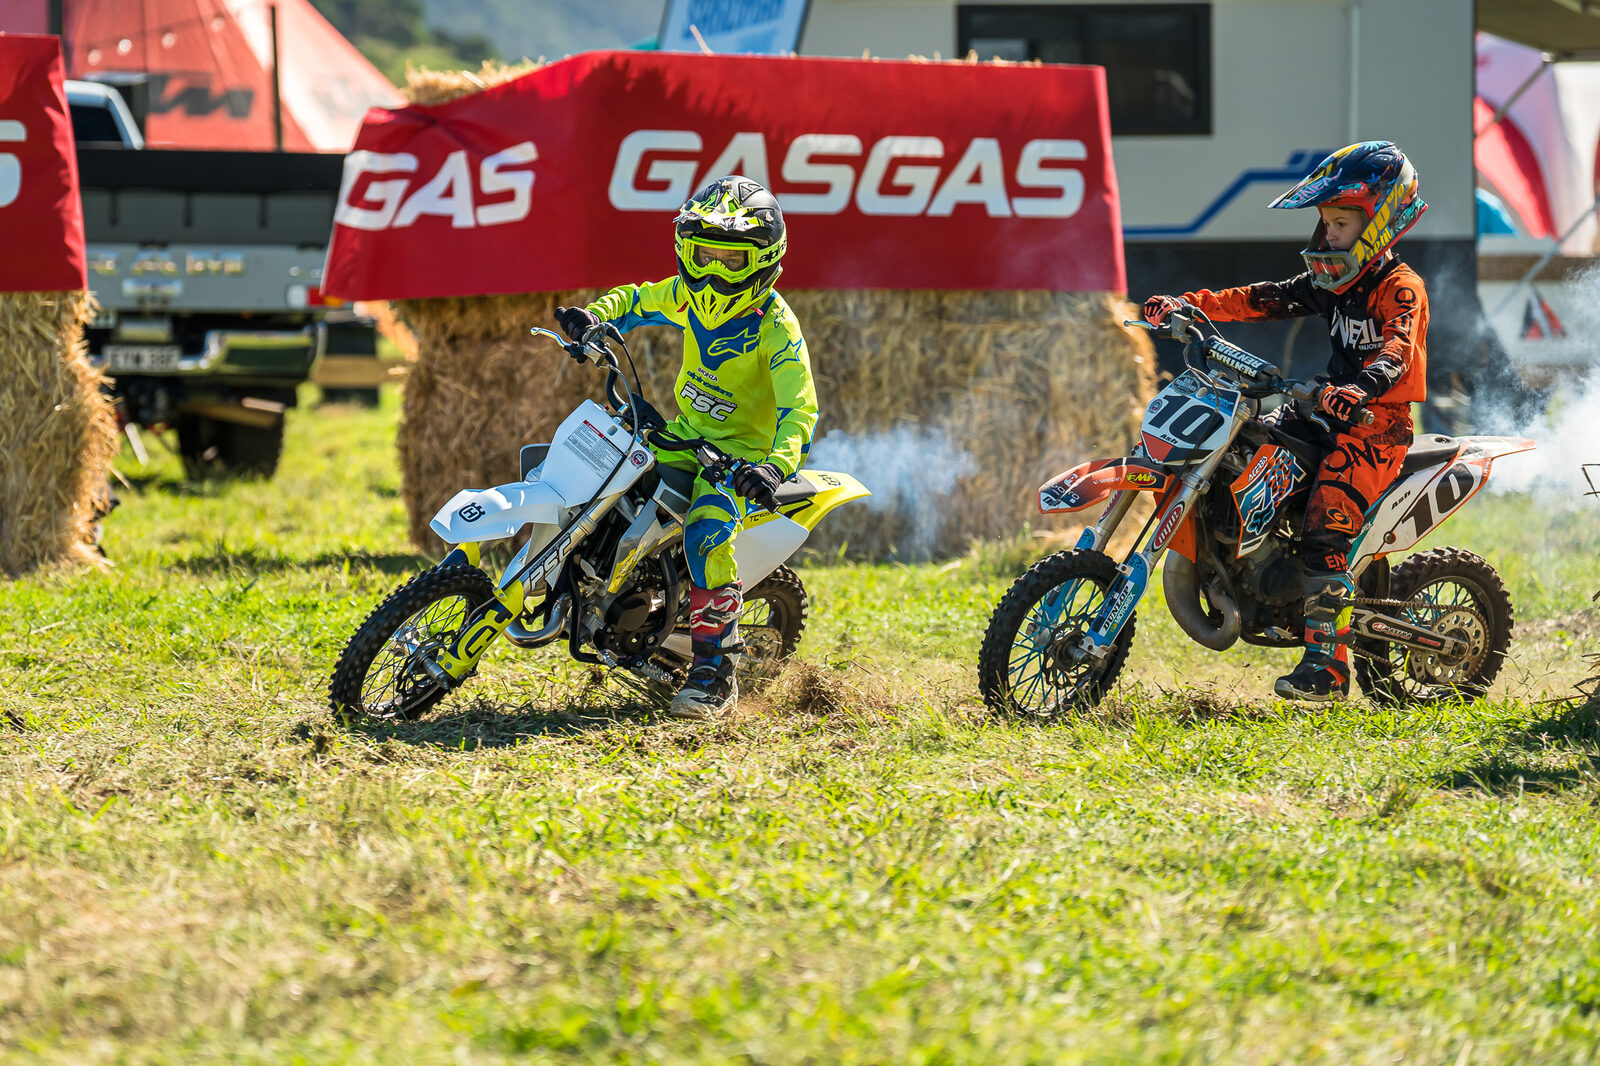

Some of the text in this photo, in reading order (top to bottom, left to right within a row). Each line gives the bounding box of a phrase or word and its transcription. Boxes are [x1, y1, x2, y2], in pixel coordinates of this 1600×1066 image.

[334, 141, 539, 231] GAS
[608, 129, 1087, 219] GASGAS
[1352, 184, 1404, 267] 100%
[1209, 349, 1258, 378] RENTHAL
[1211, 340, 1264, 369] RENTHAL
[680, 384, 735, 422] PSC
[1148, 394, 1225, 445] 10
[1160, 433, 1178, 445] Ash
[1391, 490, 1412, 510] Ash
[1402, 462, 1475, 539] 10
[529, 536, 573, 591] PSC
[1102, 585, 1130, 632] DUNLOP
[1115, 592, 1136, 625] MOTOREX
